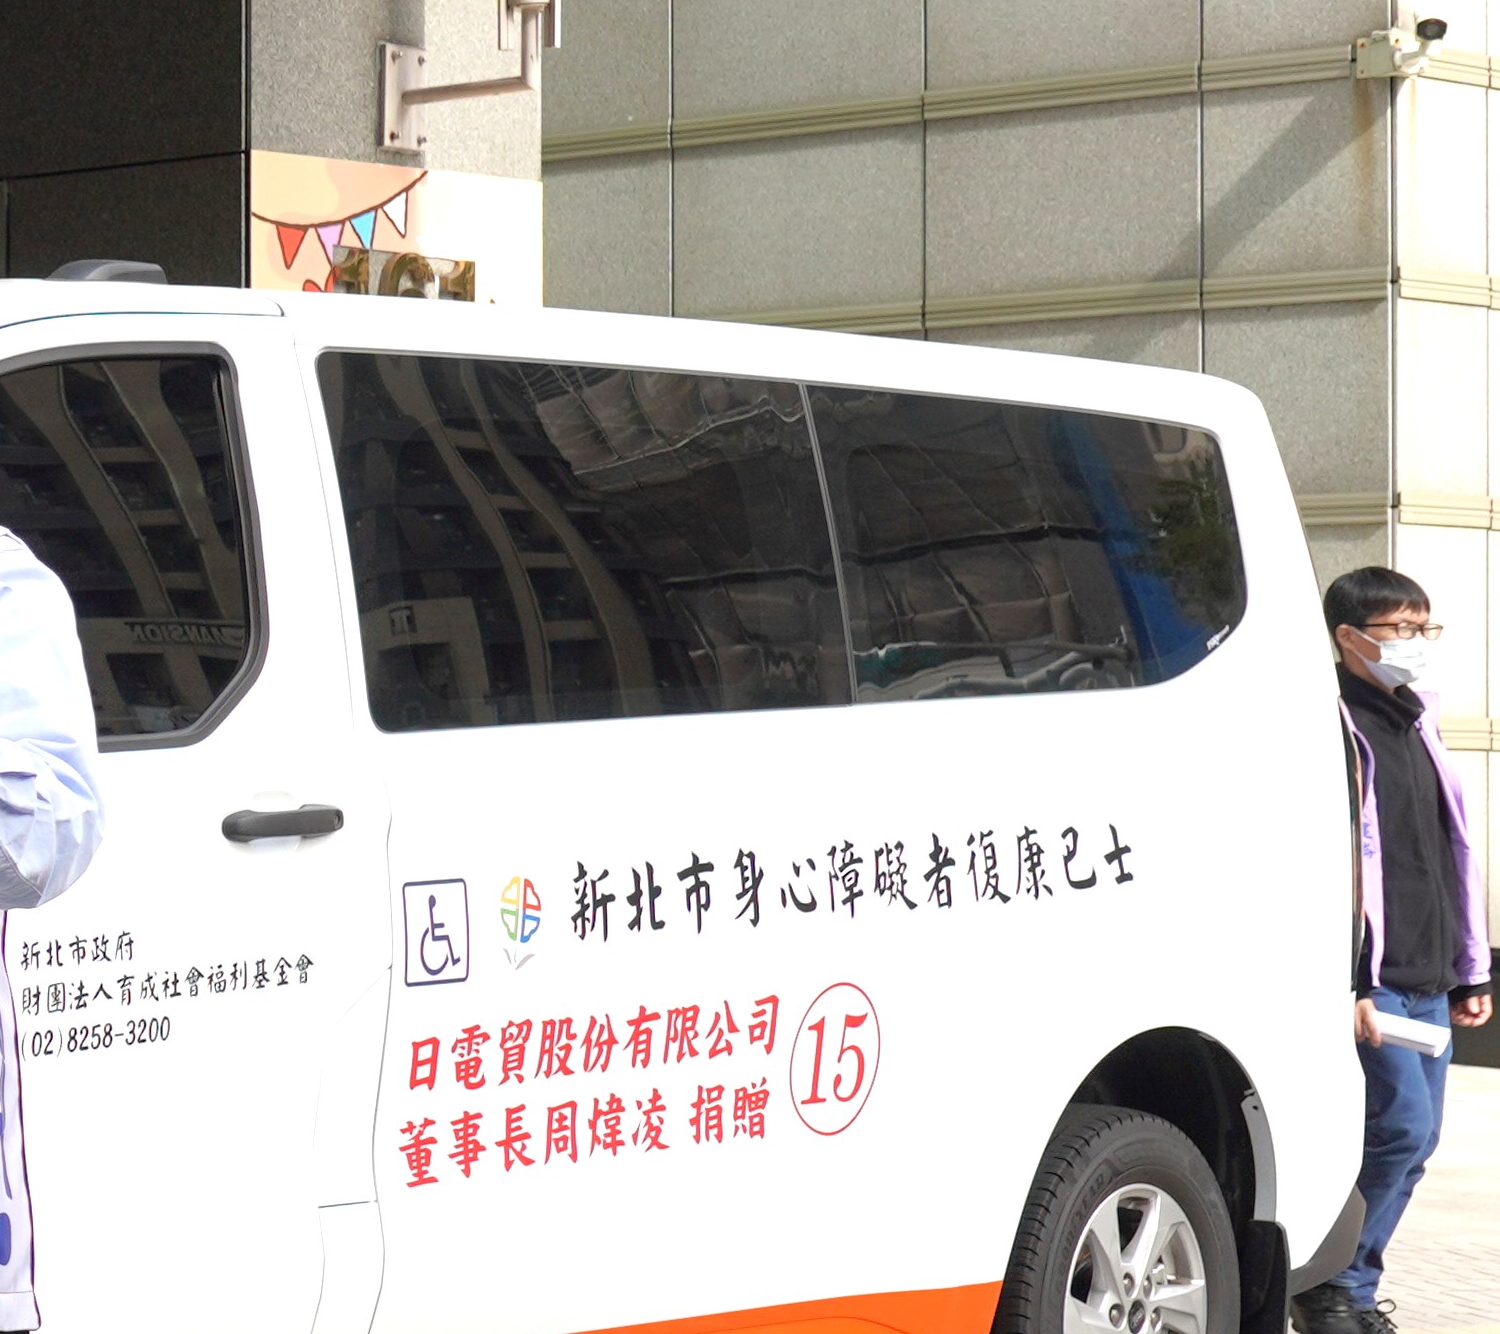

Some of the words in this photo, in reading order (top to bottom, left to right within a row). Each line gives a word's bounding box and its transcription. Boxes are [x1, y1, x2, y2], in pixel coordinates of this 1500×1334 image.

[570, 823, 1135, 942] 新北市身心障礙者復康巴士
[20, 931, 135, 971] 新北市政府
[20, 953, 315, 1017] 財團法人育成社會福利基金會
[21, 1014, 171, 1062] (02)8258-3200
[408, 994, 780, 1091] 日電貿股份有限公司
[801, 1011, 868, 1105] 15
[398, 1086, 670, 1188] 董事長周煒凌
[689, 1075, 770, 1145] 捐贈
